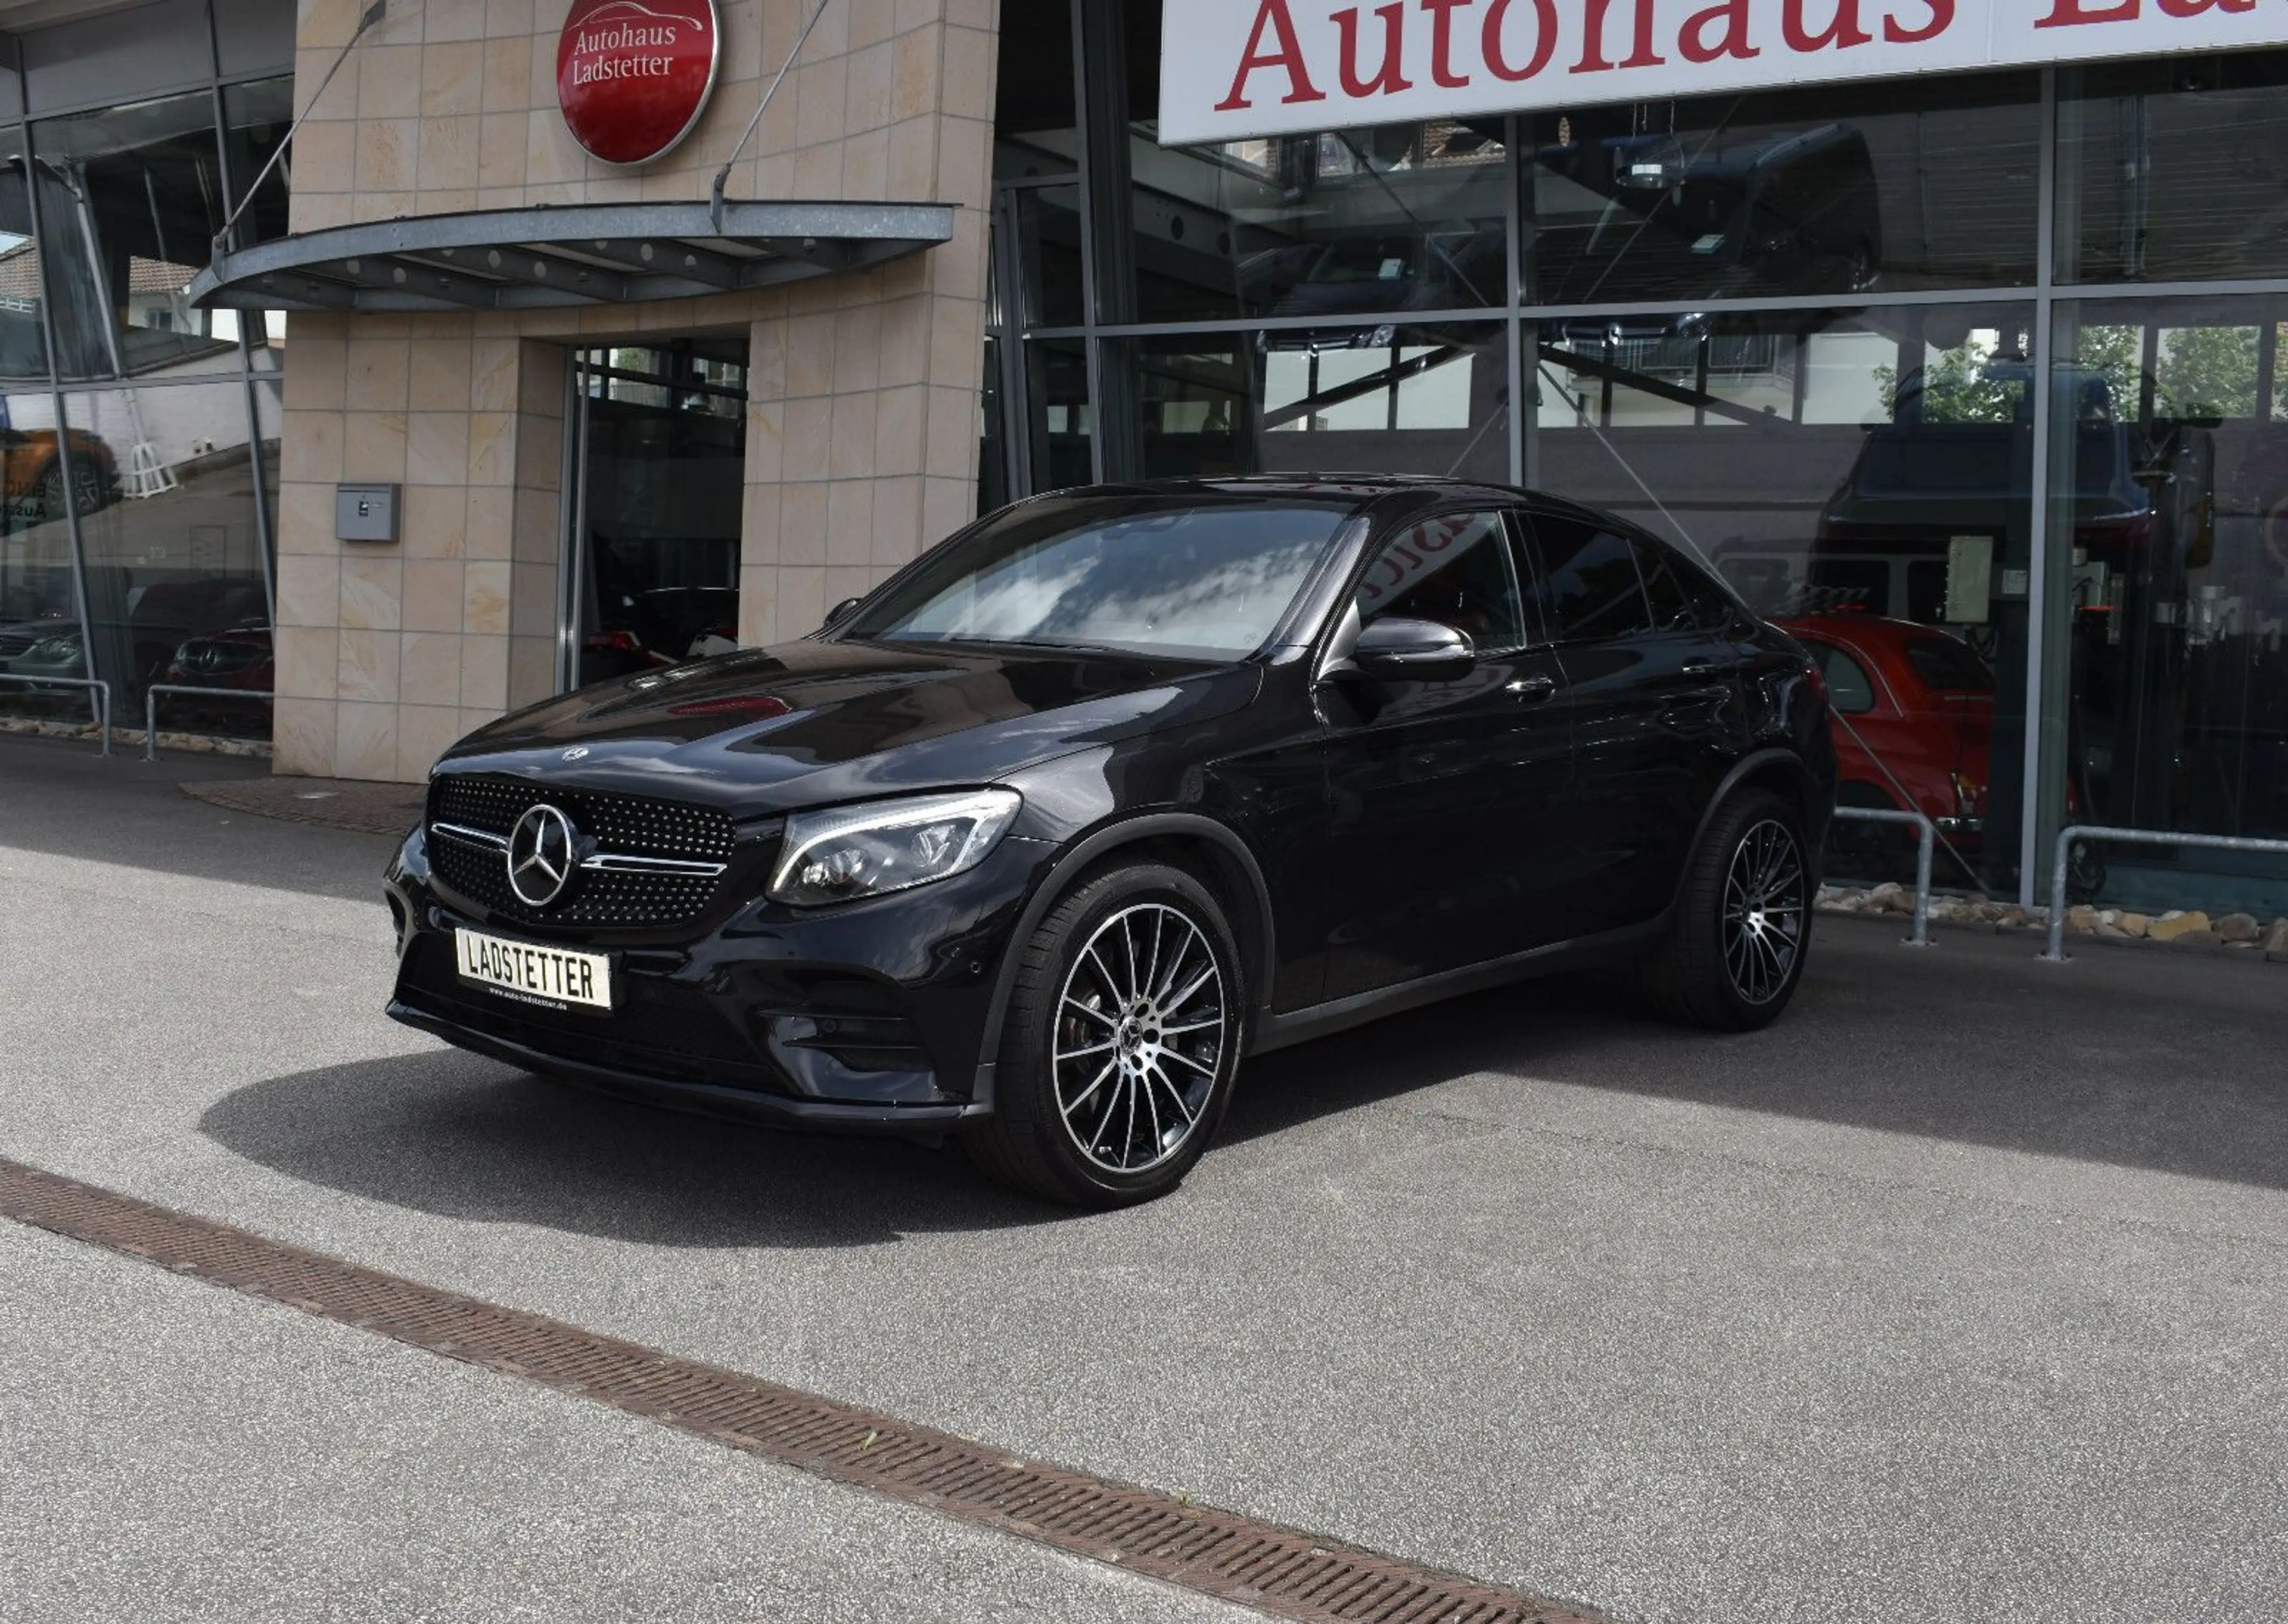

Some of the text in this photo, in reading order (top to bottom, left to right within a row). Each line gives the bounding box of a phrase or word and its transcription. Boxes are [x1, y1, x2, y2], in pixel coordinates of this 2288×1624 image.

[574, 23, 676, 55] Autohaus
[573, 54, 673, 85] Ladstetter
[1214, 0, 1955, 111] Autohaus
[467, 934, 593, 999] LADSTETTER
[489, 987, 567, 1010] www.auto-ladstetter.de
